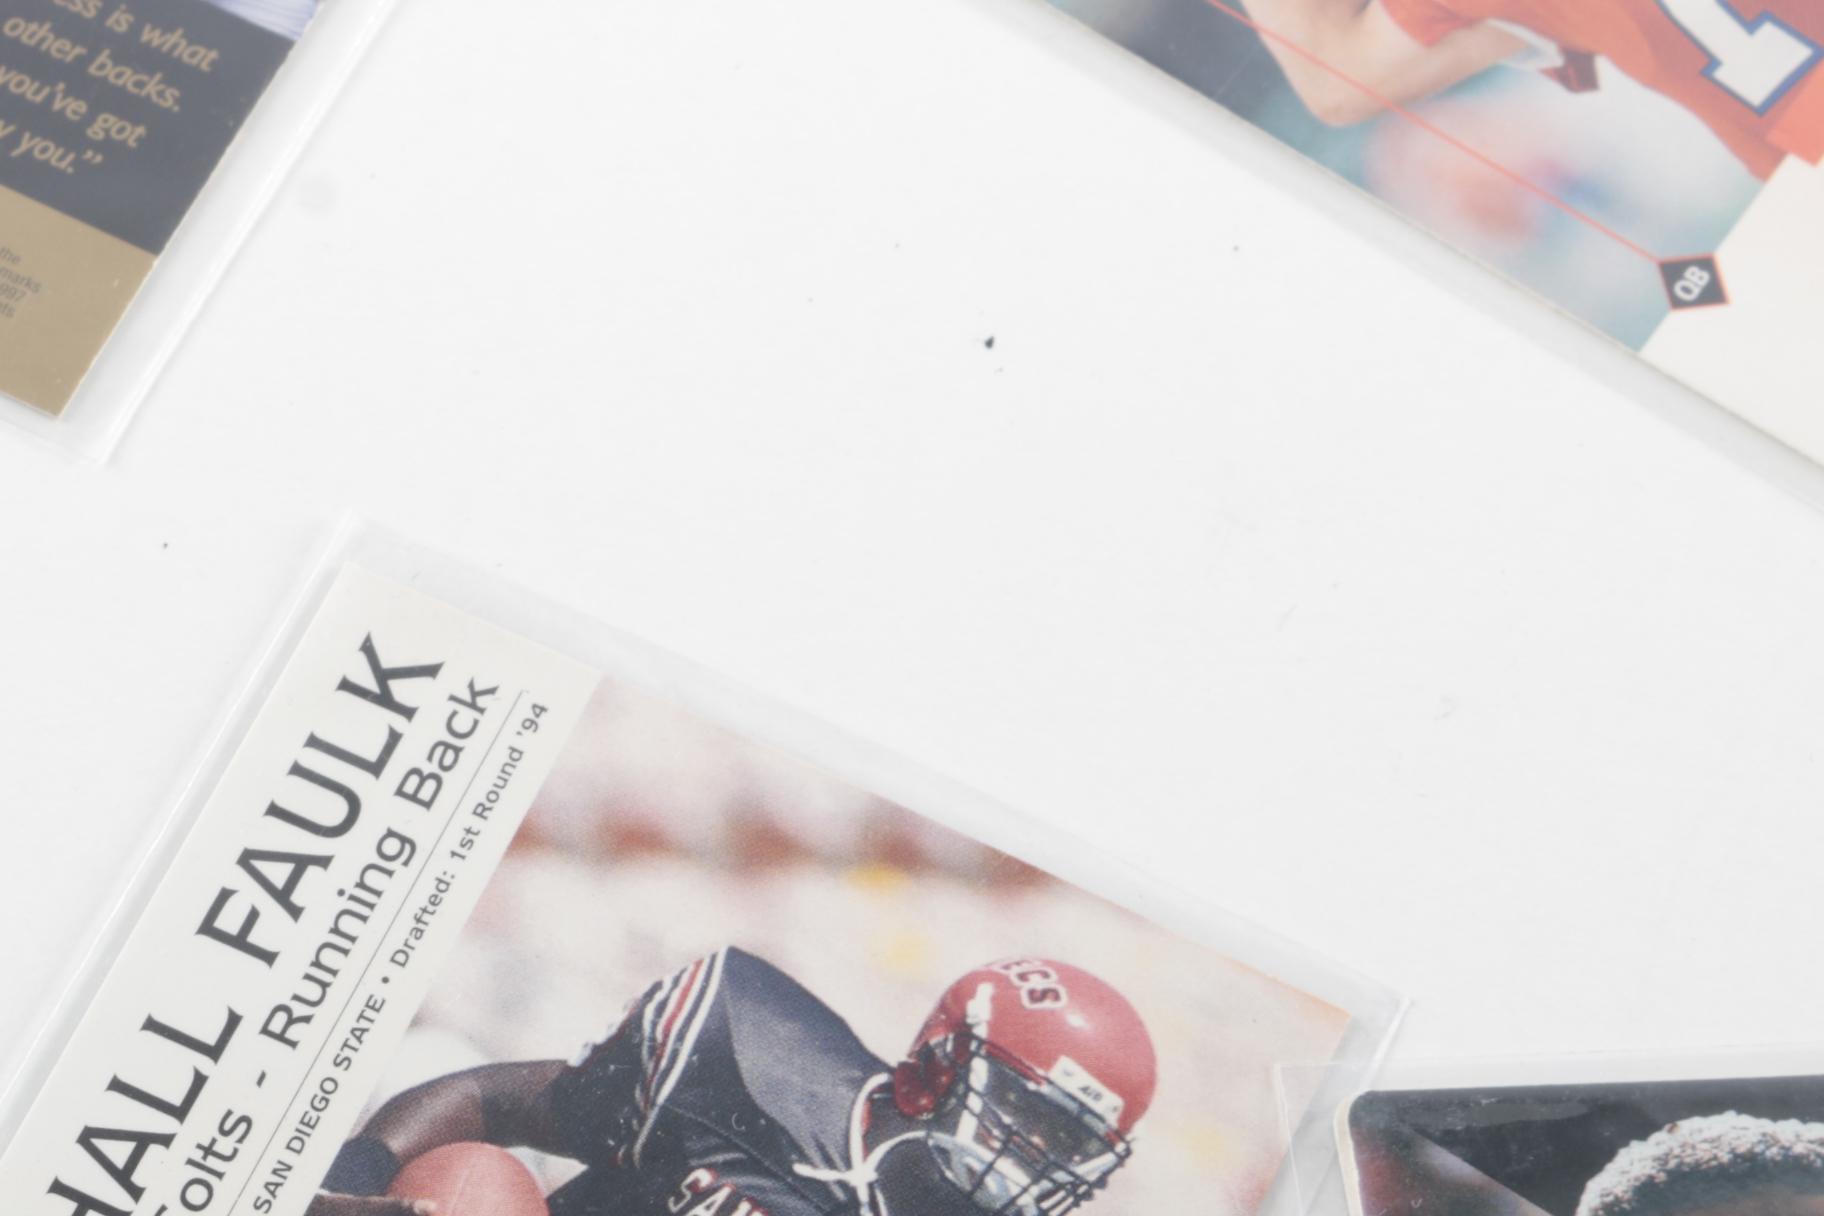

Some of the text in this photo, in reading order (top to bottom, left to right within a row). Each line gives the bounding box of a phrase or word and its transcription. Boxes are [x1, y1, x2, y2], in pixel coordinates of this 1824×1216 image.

[2, 17, 180, 112] other backs.
[103, 3, 135, 33] is
[139, 22, 220, 72] what
[85, 112, 146, 148] got
[1674, 265, 1711, 302] QB
[195, 634, 443, 967] FAULK
[258, 827, 417, 1049] Running
[393, 678, 498, 810] Back
[252, 1159, 294, 1214] SAN
[284, 1075, 339, 1155] DIEGO
[332, 993, 386, 1071] STATE
[389, 870, 451, 968] Drafted:
[450, 826, 481, 860] 1st
[471, 745, 524, 820] Round
